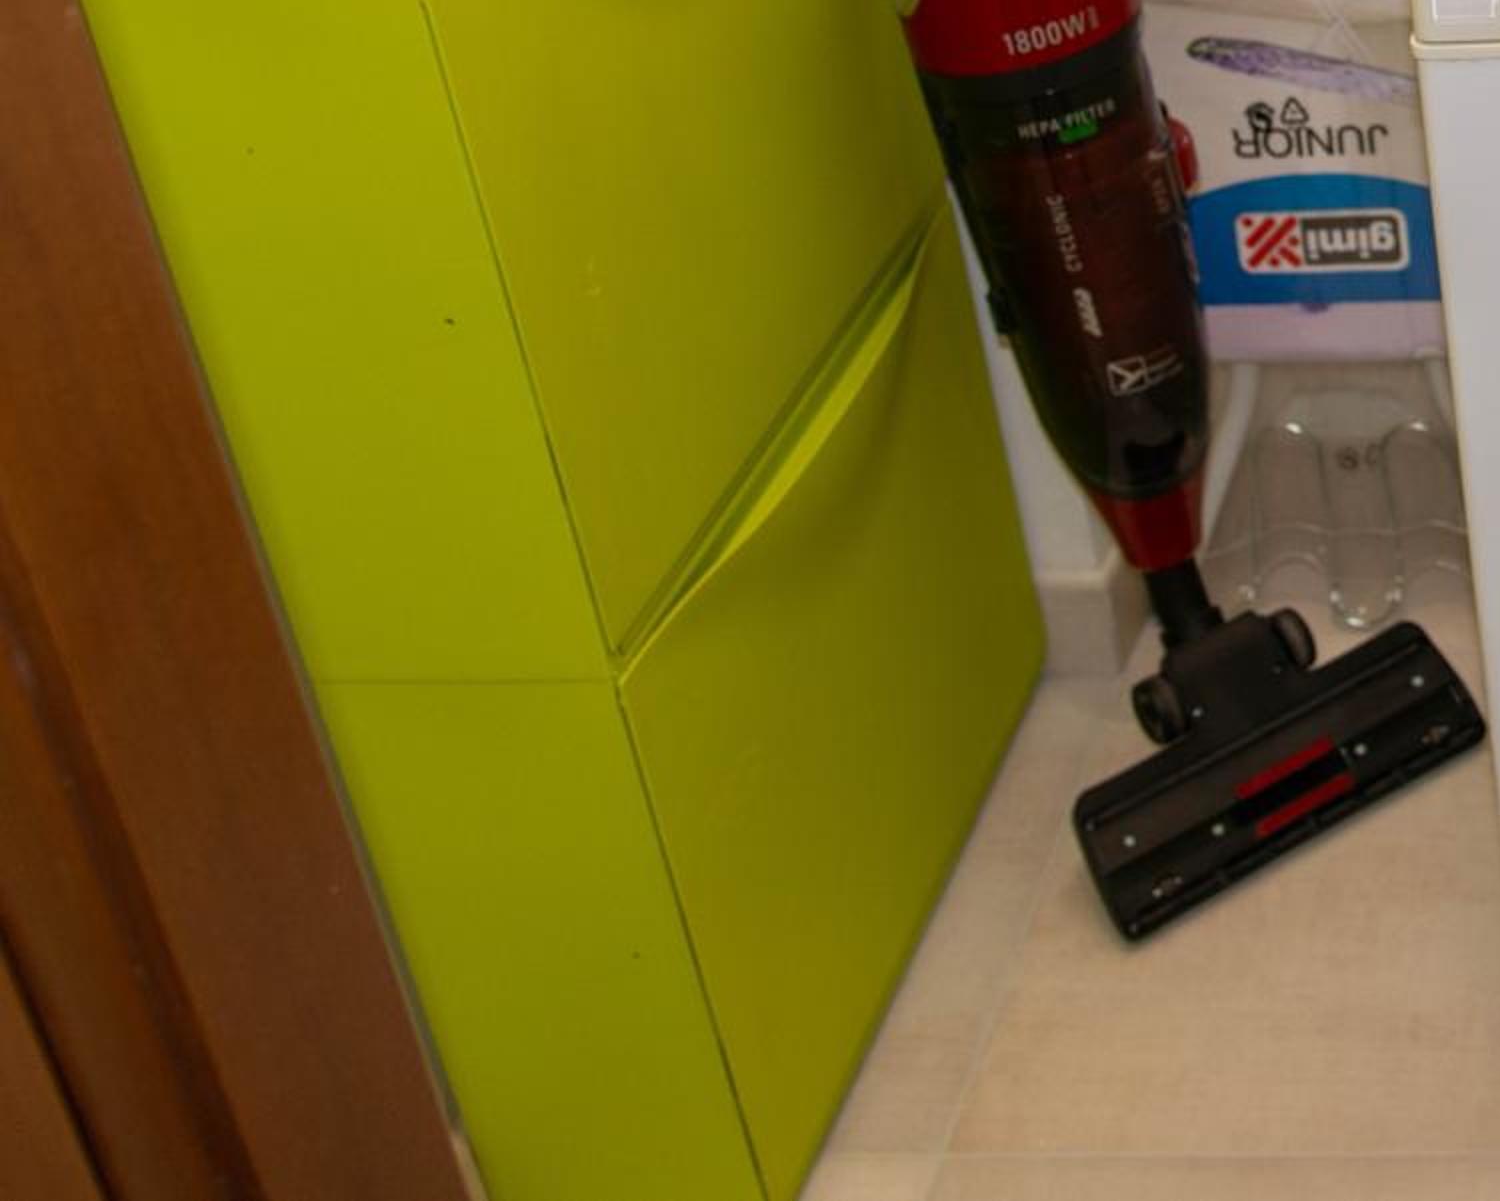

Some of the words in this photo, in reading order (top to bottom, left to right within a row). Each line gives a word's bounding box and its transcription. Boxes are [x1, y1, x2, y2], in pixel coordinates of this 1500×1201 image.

[1001, 10, 1088, 56] 1800W
[1231, 124, 1389, 159] JUNIOR
[1305, 220, 1396, 260] gimi
